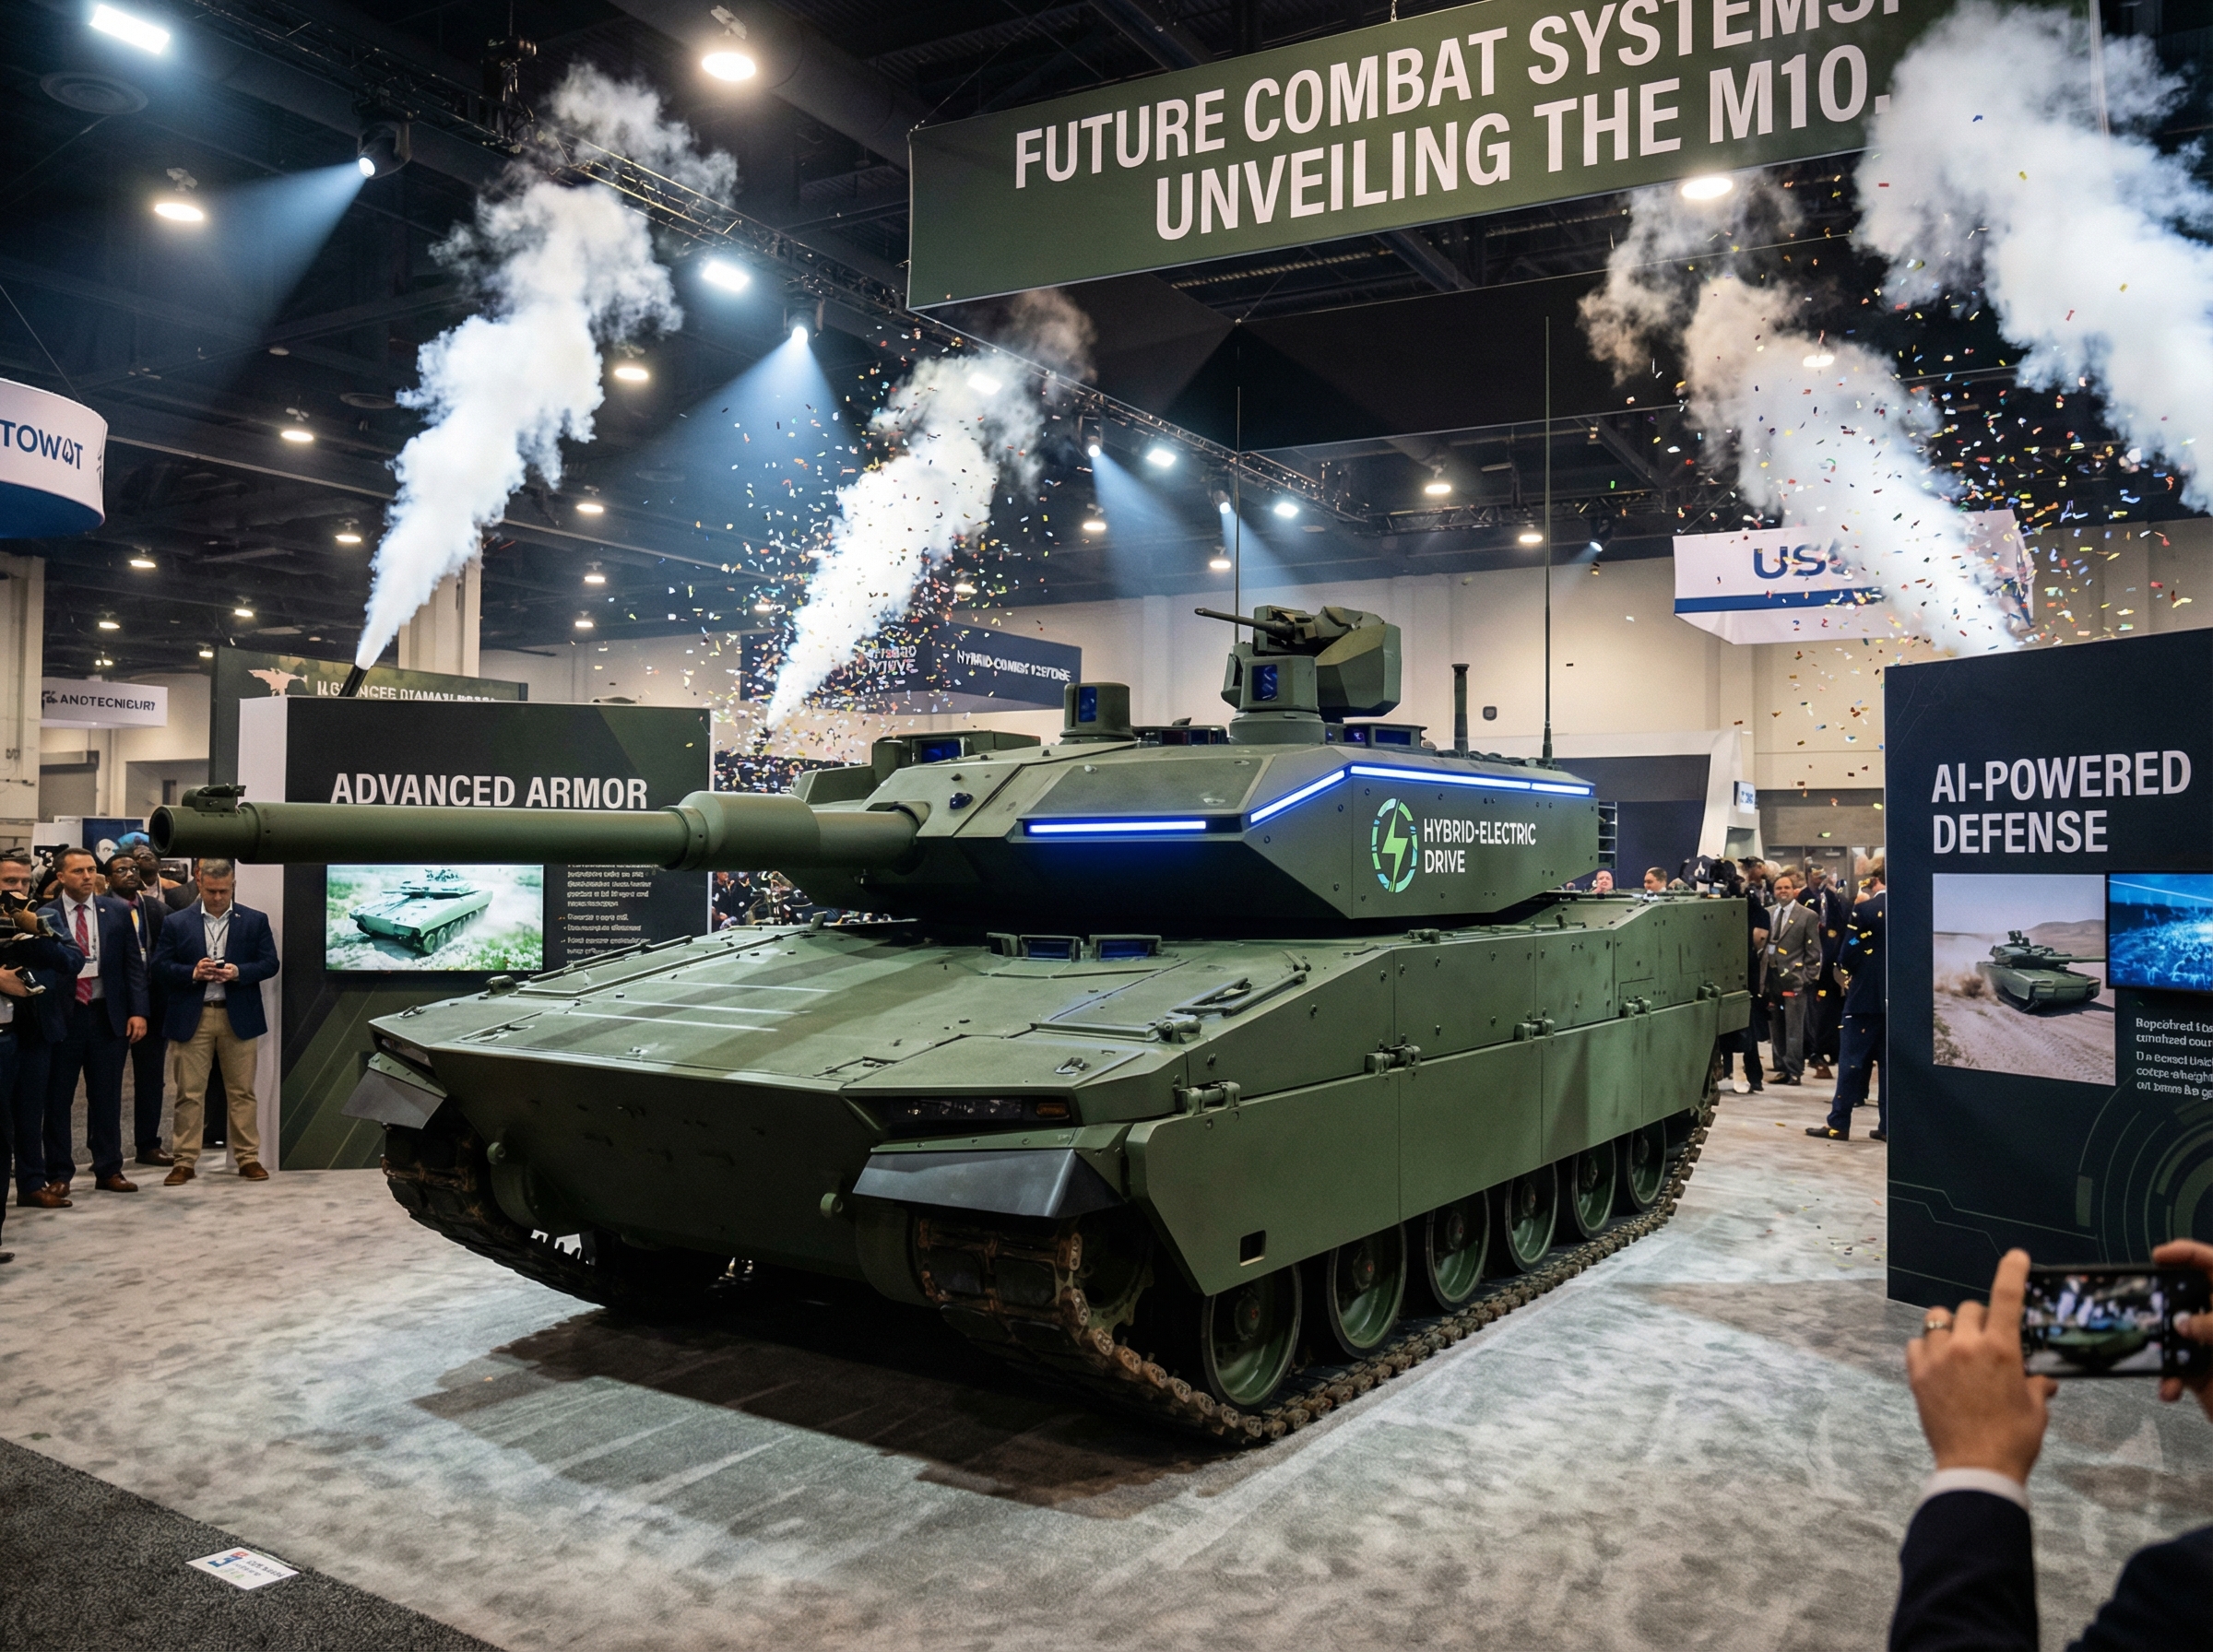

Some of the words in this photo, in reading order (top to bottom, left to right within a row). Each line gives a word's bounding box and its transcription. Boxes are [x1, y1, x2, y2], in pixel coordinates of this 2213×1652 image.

[1016, 89, 1225, 188] FUTURE
[1244, 27, 1507, 143] COMBAT
[1156, 113, 1510, 241] UNVEILING
[1533, 77, 1681, 172] THE
[330, 773, 515, 807] ADVANCED
[526, 777, 647, 808] ARMOR
[1932, 750, 2192, 803] AI-POWERED
[1424, 819, 1537, 845] HYBRID-ELECTRIC
[1933, 809, 2108, 854] DEFENSE
[1425, 850, 1465, 873] DRIVE
